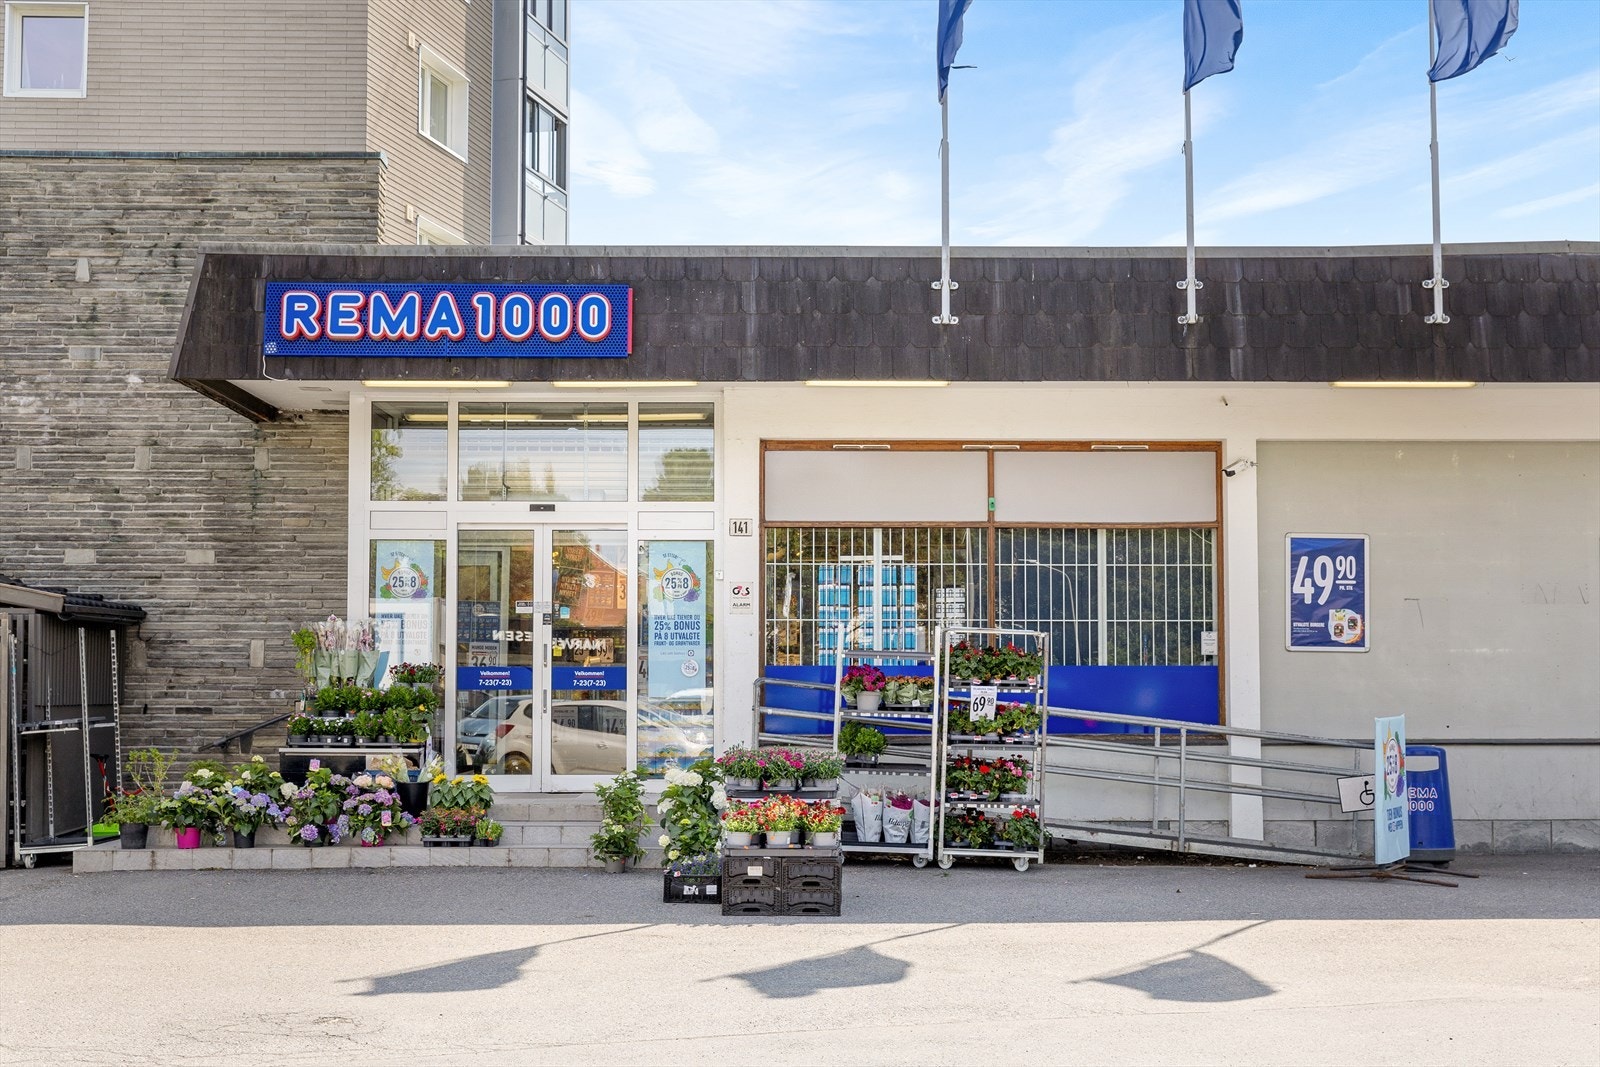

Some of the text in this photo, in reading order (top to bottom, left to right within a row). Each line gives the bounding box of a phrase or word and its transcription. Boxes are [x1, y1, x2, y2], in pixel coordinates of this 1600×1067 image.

[280, 290, 612, 342] REMA 1000
[732, 521, 748, 534] 141
[392, 576, 404, 588] 25
[410, 576, 416, 588] 8
[665, 578, 676, 589] 25
[683, 578, 688, 589] 8
[1293, 555, 1356, 605] 49 90
[400, 620, 427, 629] BONUS
[654, 621, 700, 630] 25% BONUS
[654, 631, 662, 640] PÅ
[489, 656, 496, 665] 90
[972, 696, 986, 712] 69
[1408, 787, 1438, 798] EMA
[1408, 800, 1434, 812] 000
